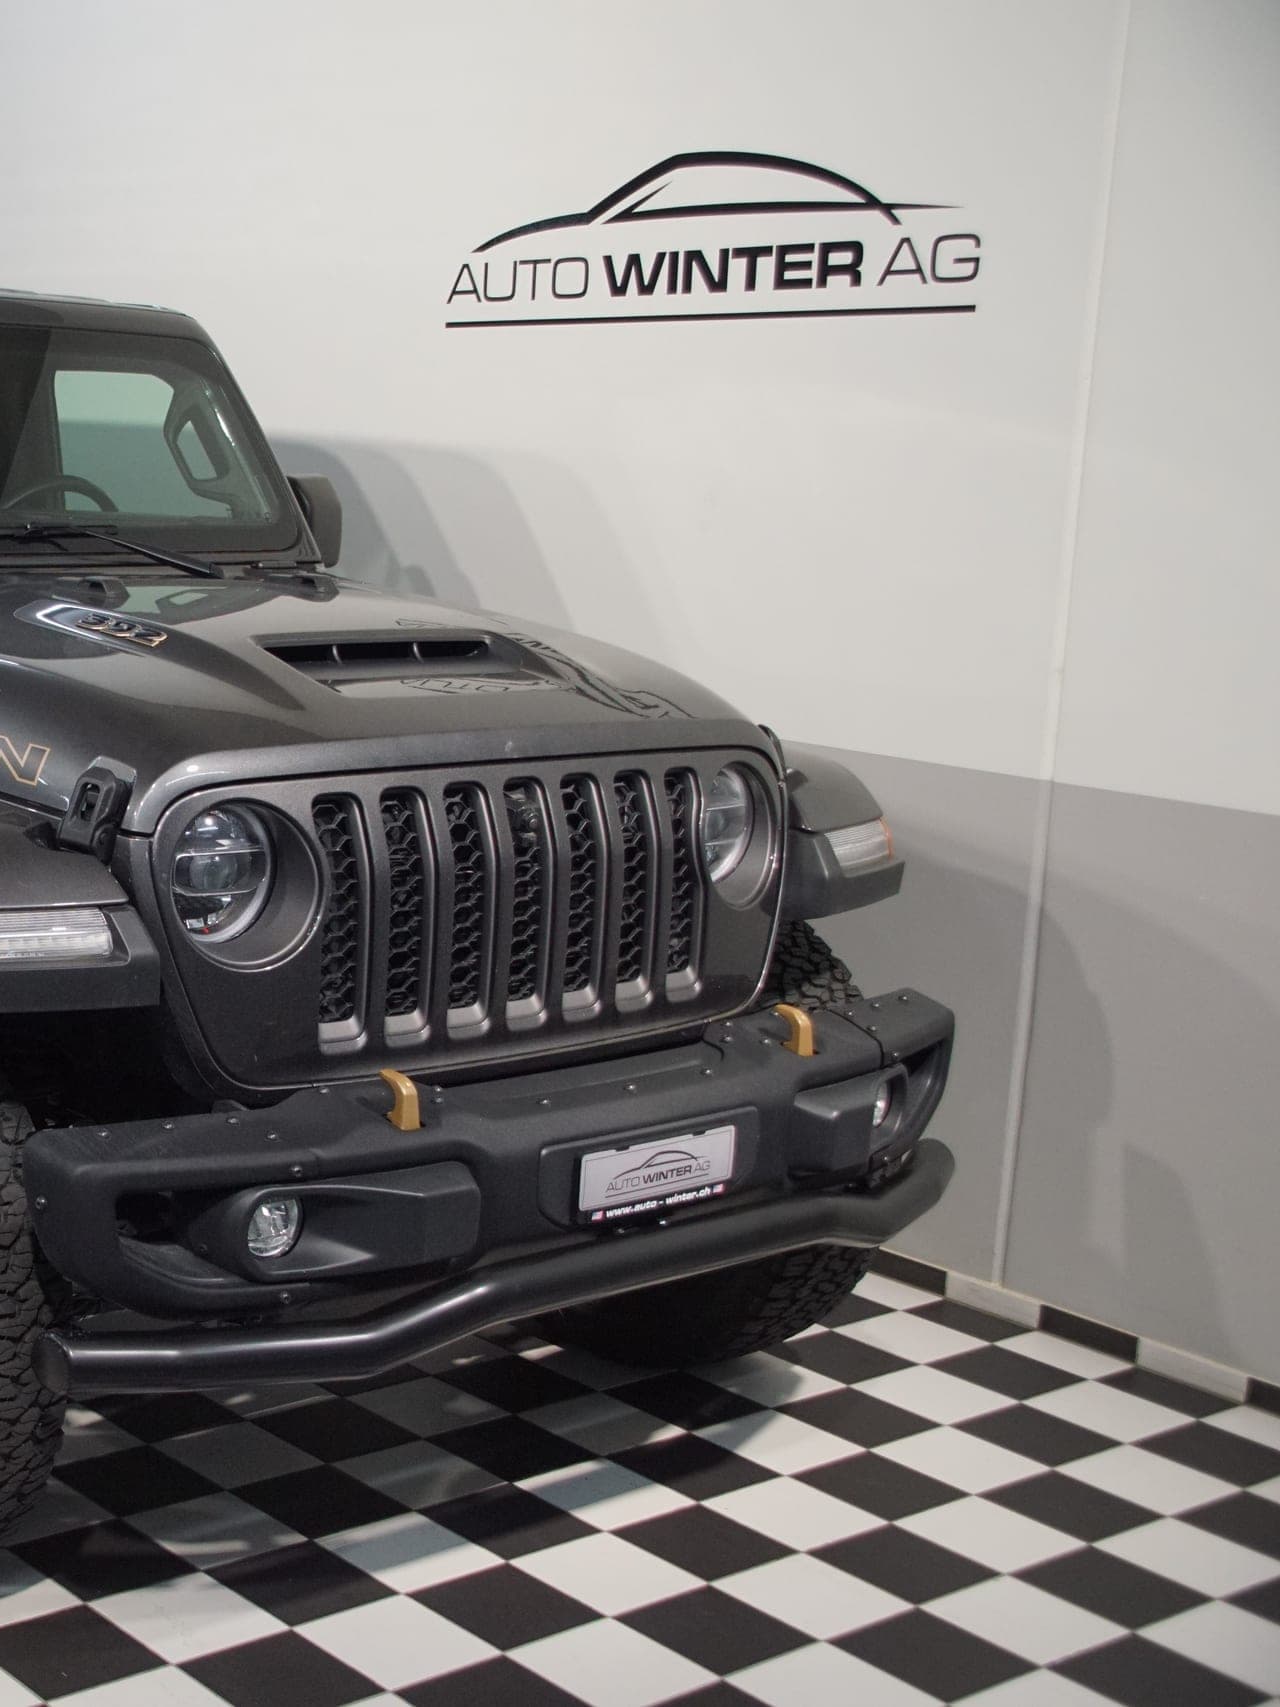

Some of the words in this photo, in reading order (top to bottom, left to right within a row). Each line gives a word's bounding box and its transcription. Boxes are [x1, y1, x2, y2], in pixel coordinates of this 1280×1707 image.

[446, 256, 590, 304] AUTO
[602, 240, 864, 297] WINTER
[876, 233, 982, 287] AG
[75, 612, 168, 648] 392
[605, 1176, 641, 1193] AUTO
[642, 1164, 692, 1185] WINTER
[694, 1160, 711, 1173] AG
